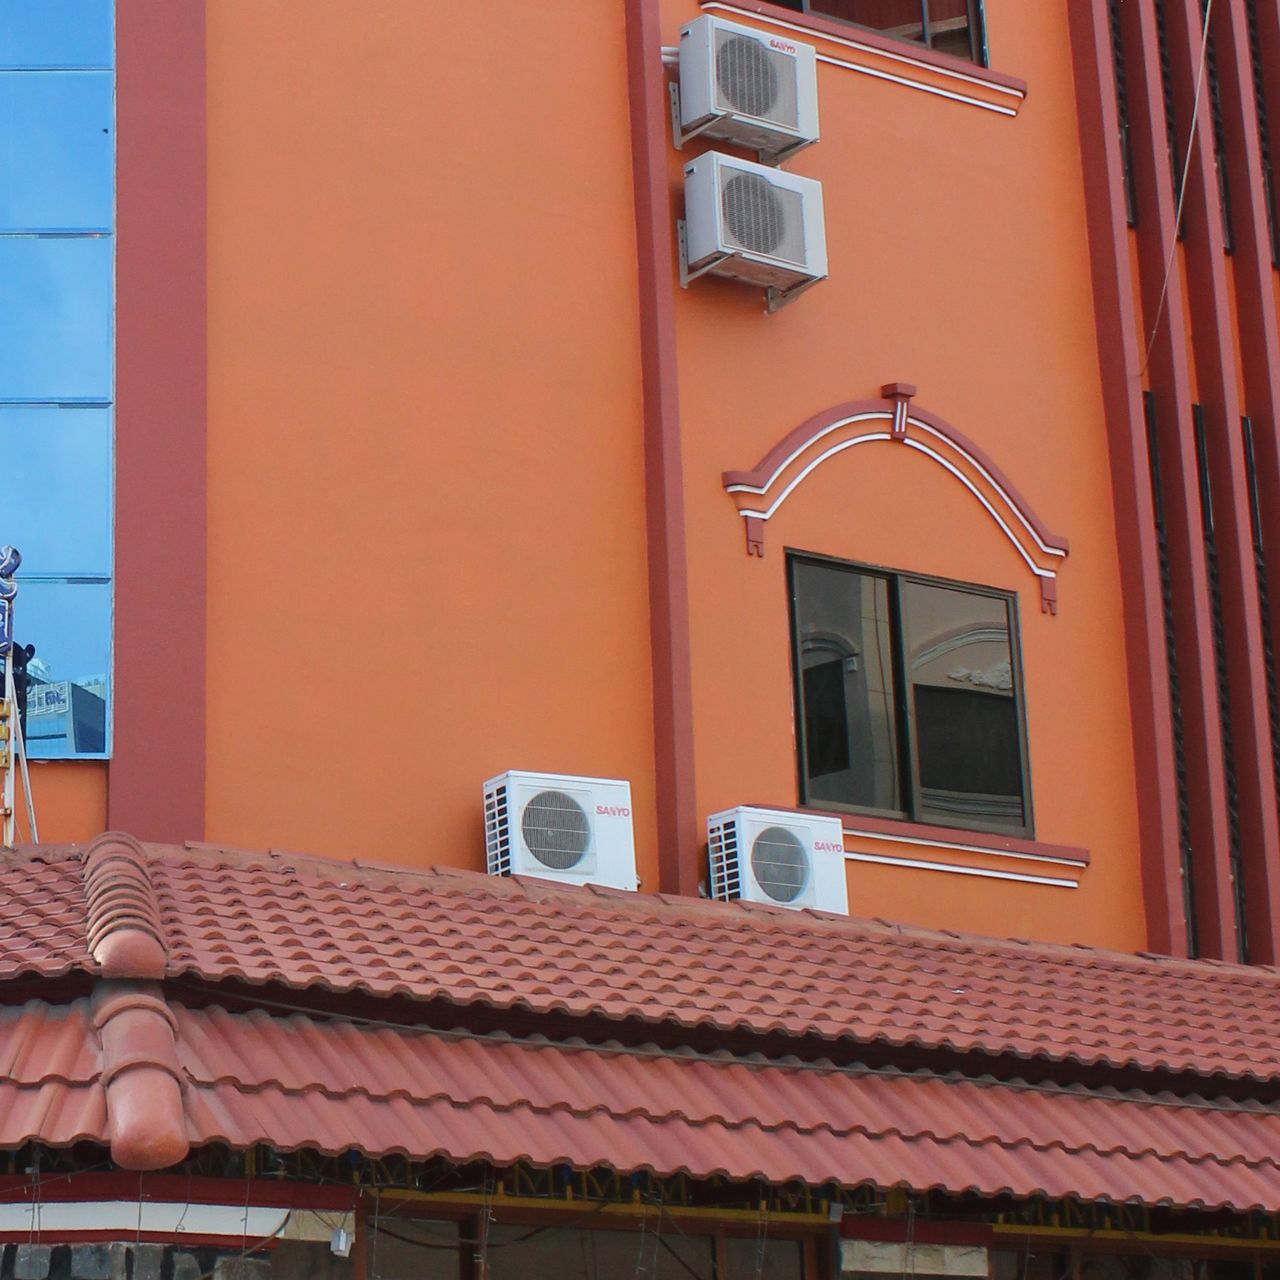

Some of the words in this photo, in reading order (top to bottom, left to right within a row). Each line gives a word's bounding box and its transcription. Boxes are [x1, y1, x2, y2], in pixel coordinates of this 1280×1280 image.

[769, 39, 796, 54] SANYO
[595, 804, 630, 817] SANYO
[814, 840, 843, 853] SANYO
